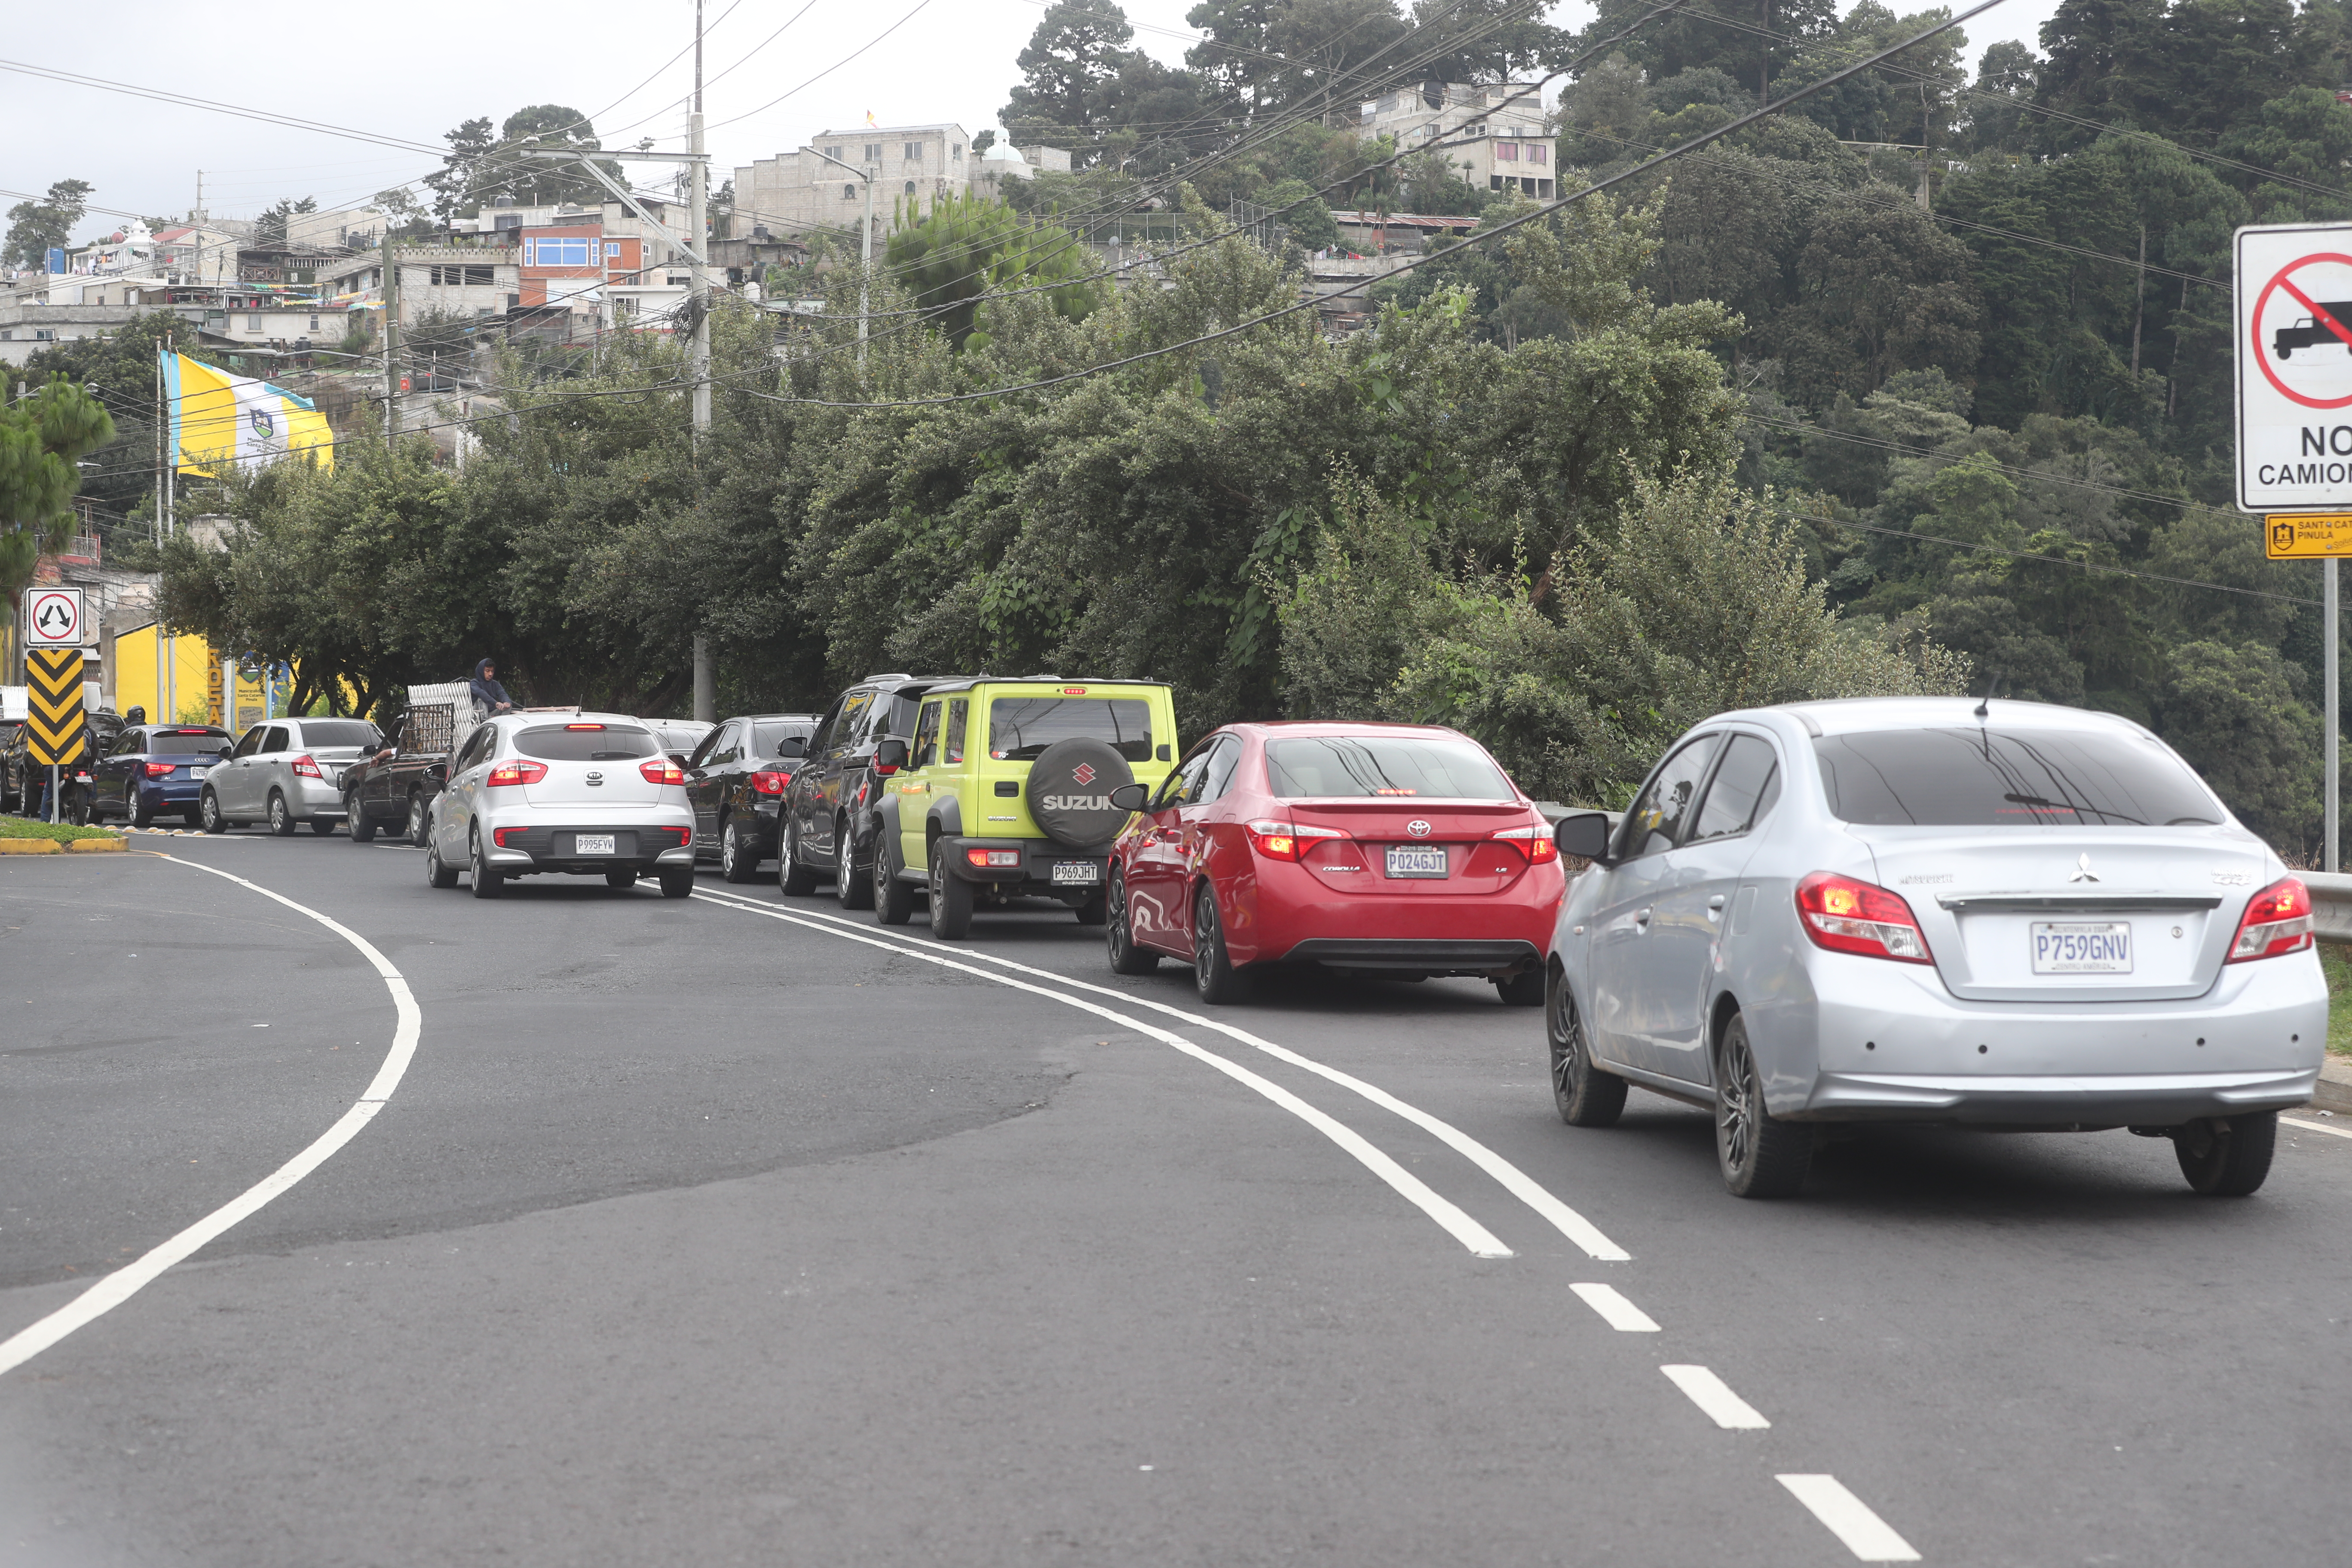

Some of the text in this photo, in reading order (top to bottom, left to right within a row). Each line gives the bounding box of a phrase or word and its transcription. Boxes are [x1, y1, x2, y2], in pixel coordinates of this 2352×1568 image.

[2301, 426, 2352, 456] NO
[2258, 462, 2352, 486] CAMIO
[2298, 521, 2331, 530] SANT
[2298, 531, 2334, 540] PINULA
[208, 649, 222, 727] ROSA
[1043, 795, 1124, 810] SUZUK
[578, 839, 613, 850] P995FYW
[1389, 854, 1444, 870] P024GJT
[1055, 867, 1096, 879] P969JHT
[1898, 873, 1955, 885] MITSUBISHI
[2037, 935, 2127, 961] P759GNV
